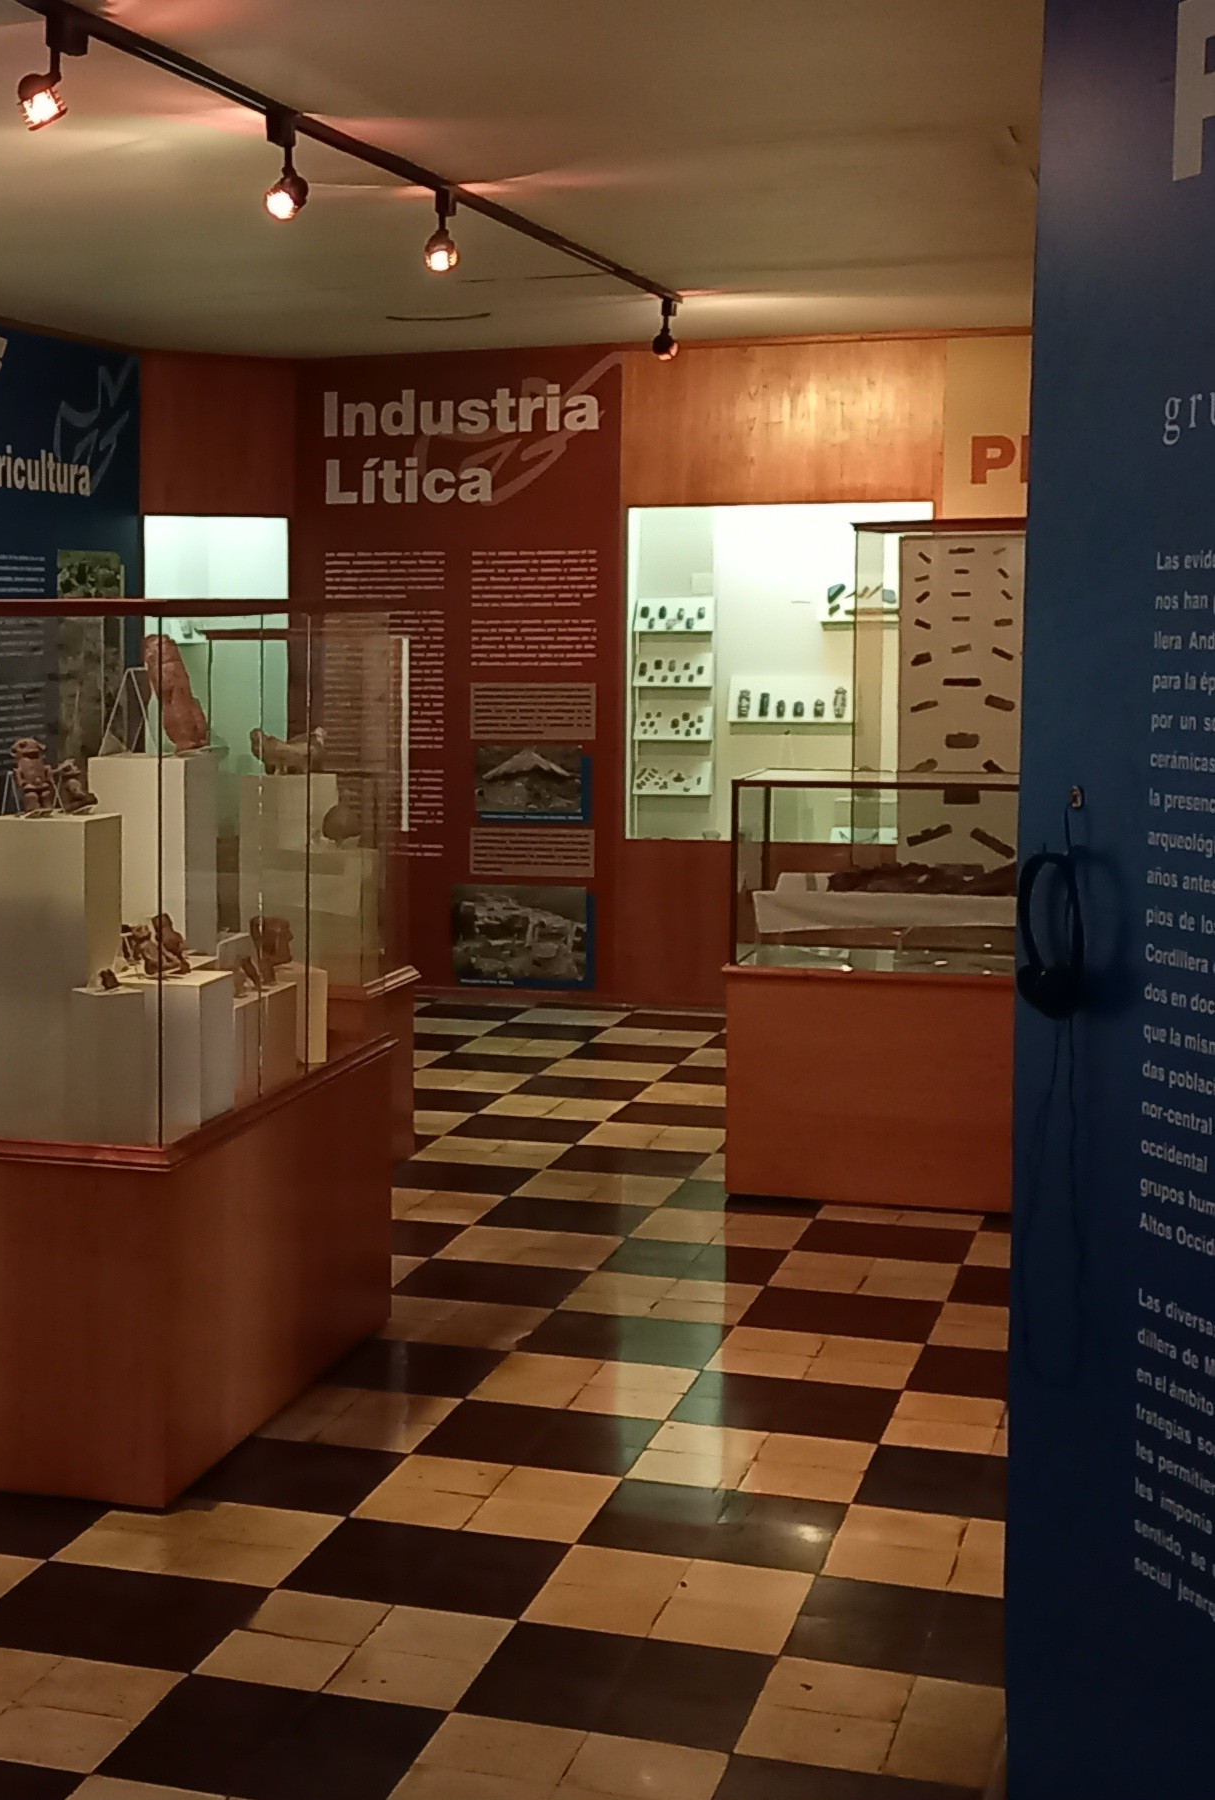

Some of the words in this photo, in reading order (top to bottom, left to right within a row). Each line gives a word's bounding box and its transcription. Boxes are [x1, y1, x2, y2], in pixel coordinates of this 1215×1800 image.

[324, 384, 599, 437] Industria
[1162, 391, 1215, 446] gr
[325, 457, 492, 504] Lítica
[1156, 551, 1181, 571] Las
[1154, 594, 1179, 610] nos
[1183, 590, 1208, 610] han
[1153, 630, 1182, 650] llera
[1152, 674, 1181, 693] para
[1184, 671, 1196, 690] la
[1150, 713, 1174, 733] por
[1180, 715, 1196, 731] un
[1203, 716, 1215, 732] s
[1149, 787, 1161, 807] la
[1146, 866, 1179, 888] años
[1178, 911, 1196, 932] de
[1145, 943, 1208, 974] Cordillera
[1144, 982, 1168, 1004] dos
[1171, 991, 1187, 1008] en
[1143, 1023, 1167, 1043] que
[1169, 1026, 1182, 1048] la
[1142, 1060, 1165, 1082] das
[1141, 1101, 1213, 1136] nor-central
[1141, 1139, 1208, 1174] occidental
[1140, 1178, 1185, 1206] grupos
[1139, 1212, 1173, 1240] Altos
[1138, 1287, 1161, 1314] Las
[1182, 1348, 1199, 1370] de
[1197, 1436, 1215, 1458] so
